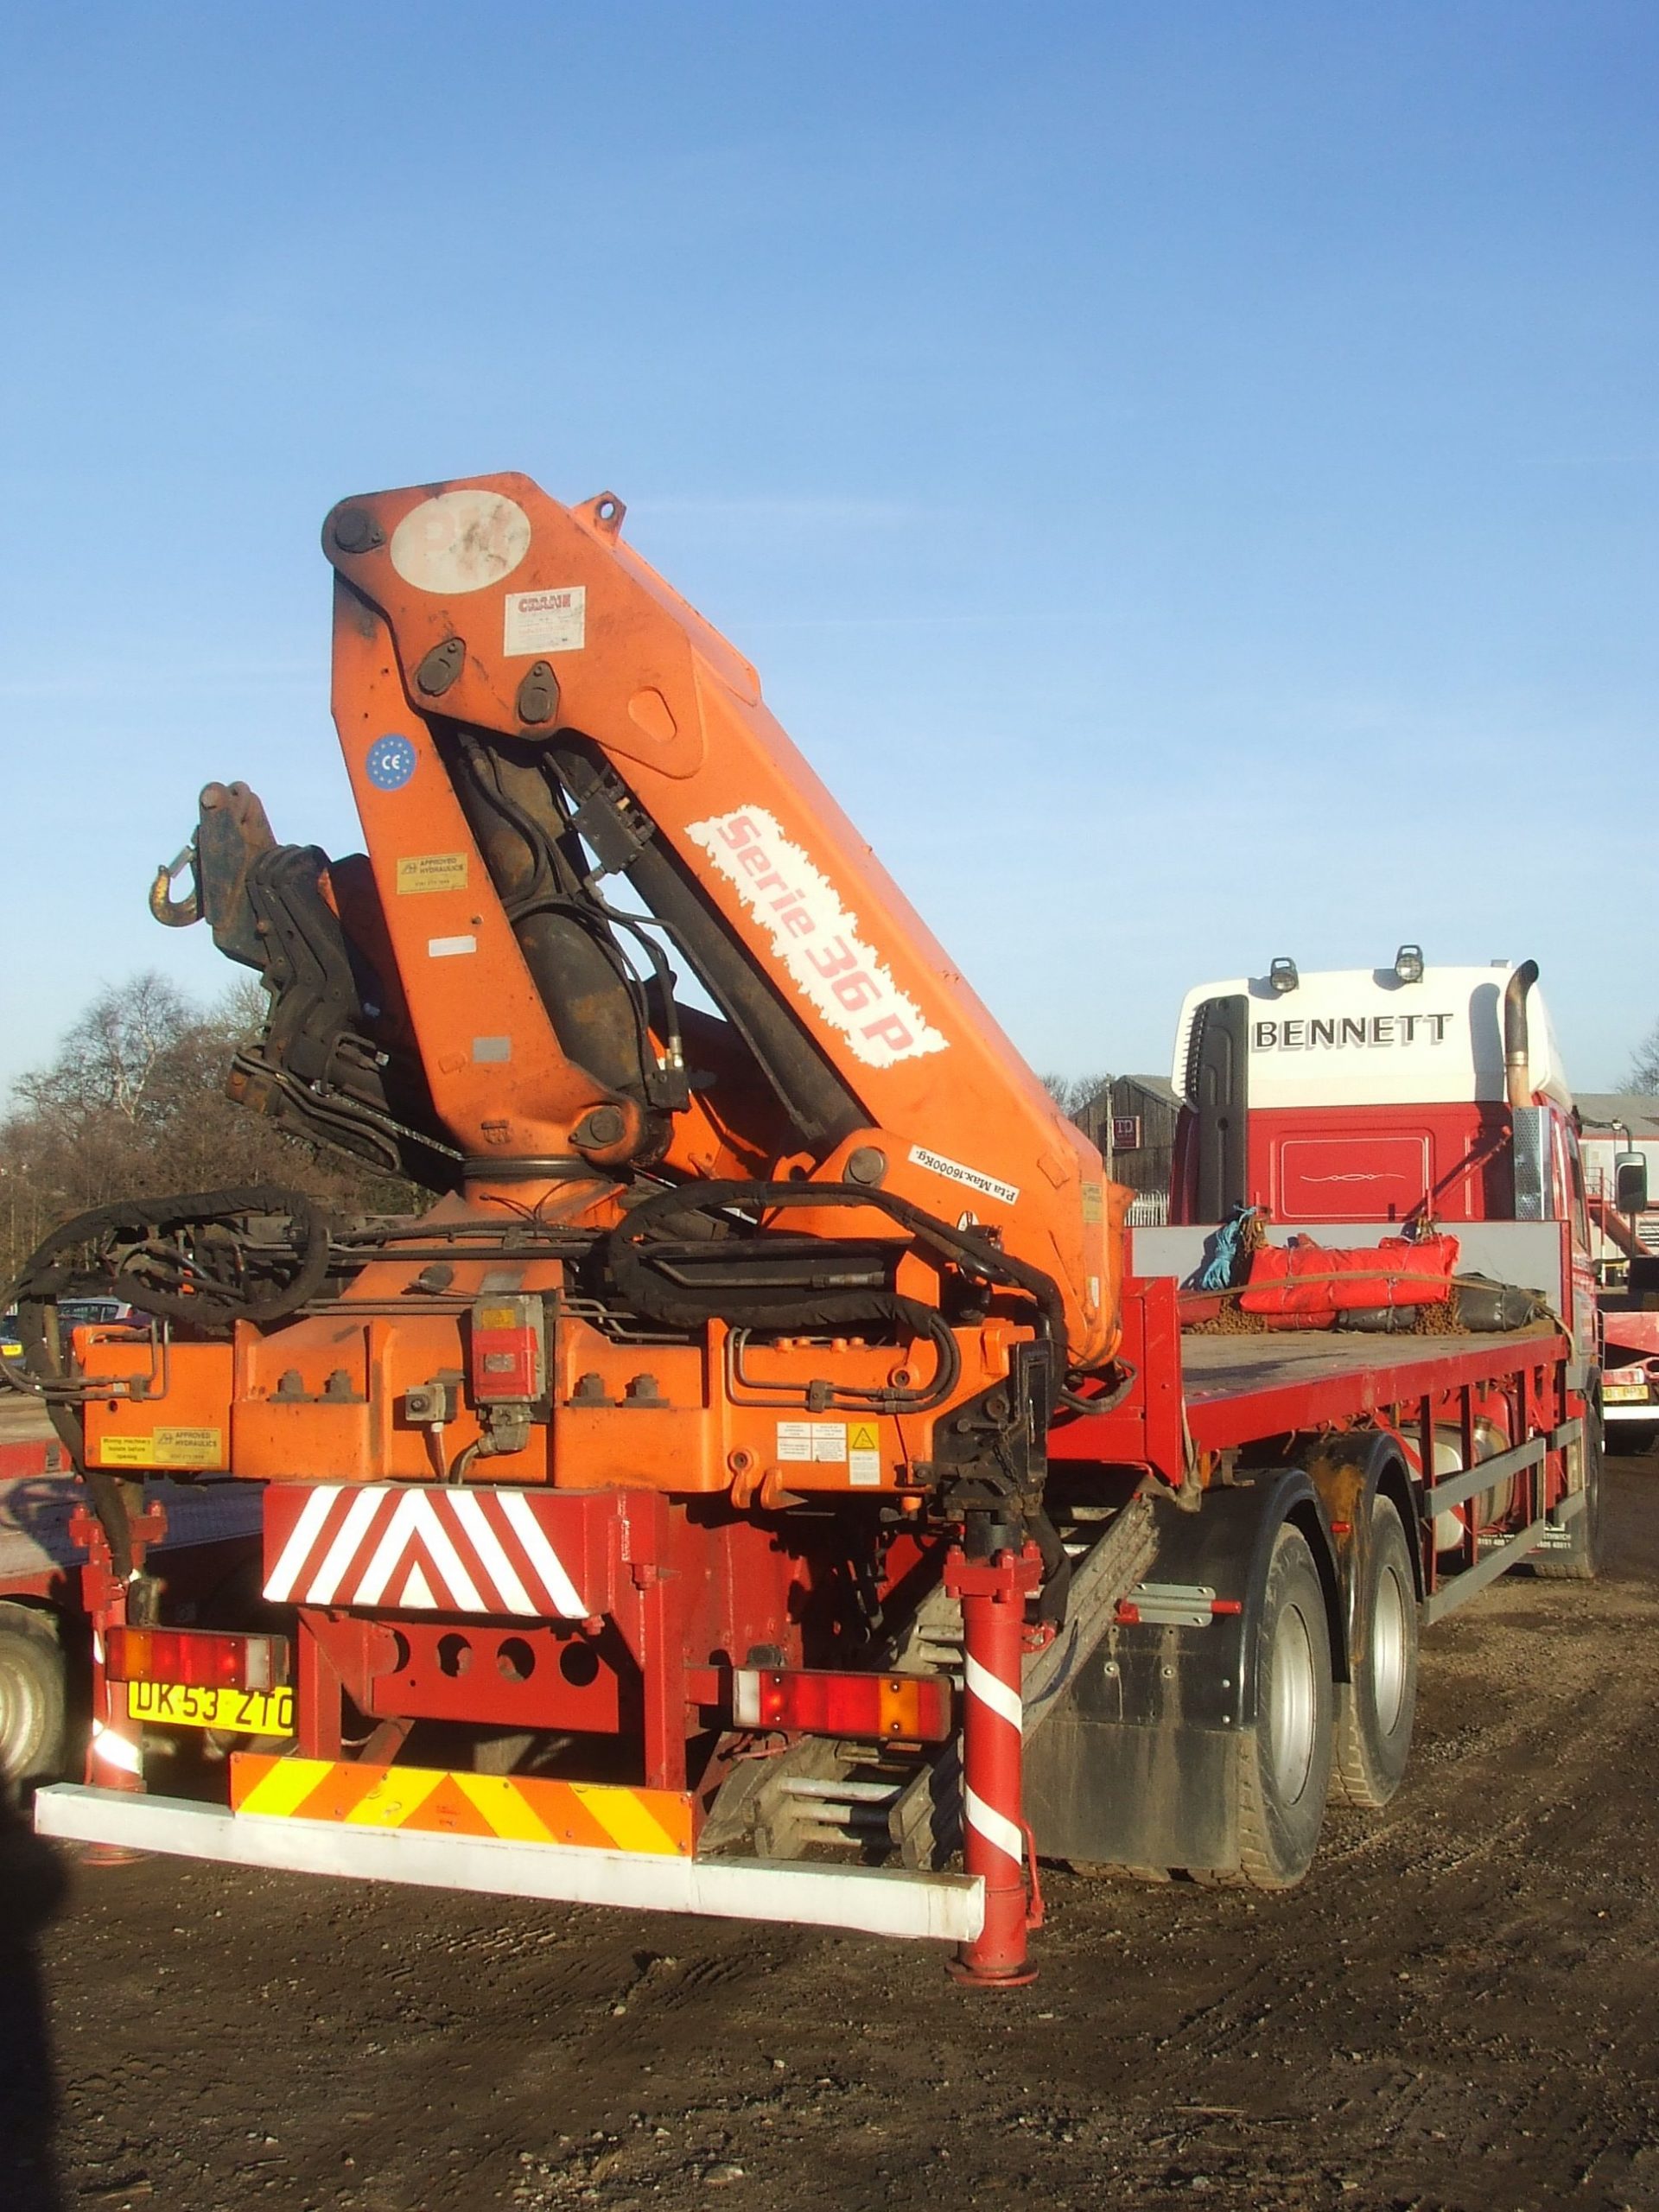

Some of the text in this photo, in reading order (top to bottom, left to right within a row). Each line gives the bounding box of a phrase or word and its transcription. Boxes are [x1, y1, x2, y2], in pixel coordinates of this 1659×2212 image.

[382, 754, 400, 770] CE
[420, 864, 464, 874] HYDRAULICS
[716, 816, 817, 938] Serie
[804, 936, 882, 1012] 36
[1253, 1014, 1453, 1051] BENNETT
[1115, 1119, 1134, 1134] TD
